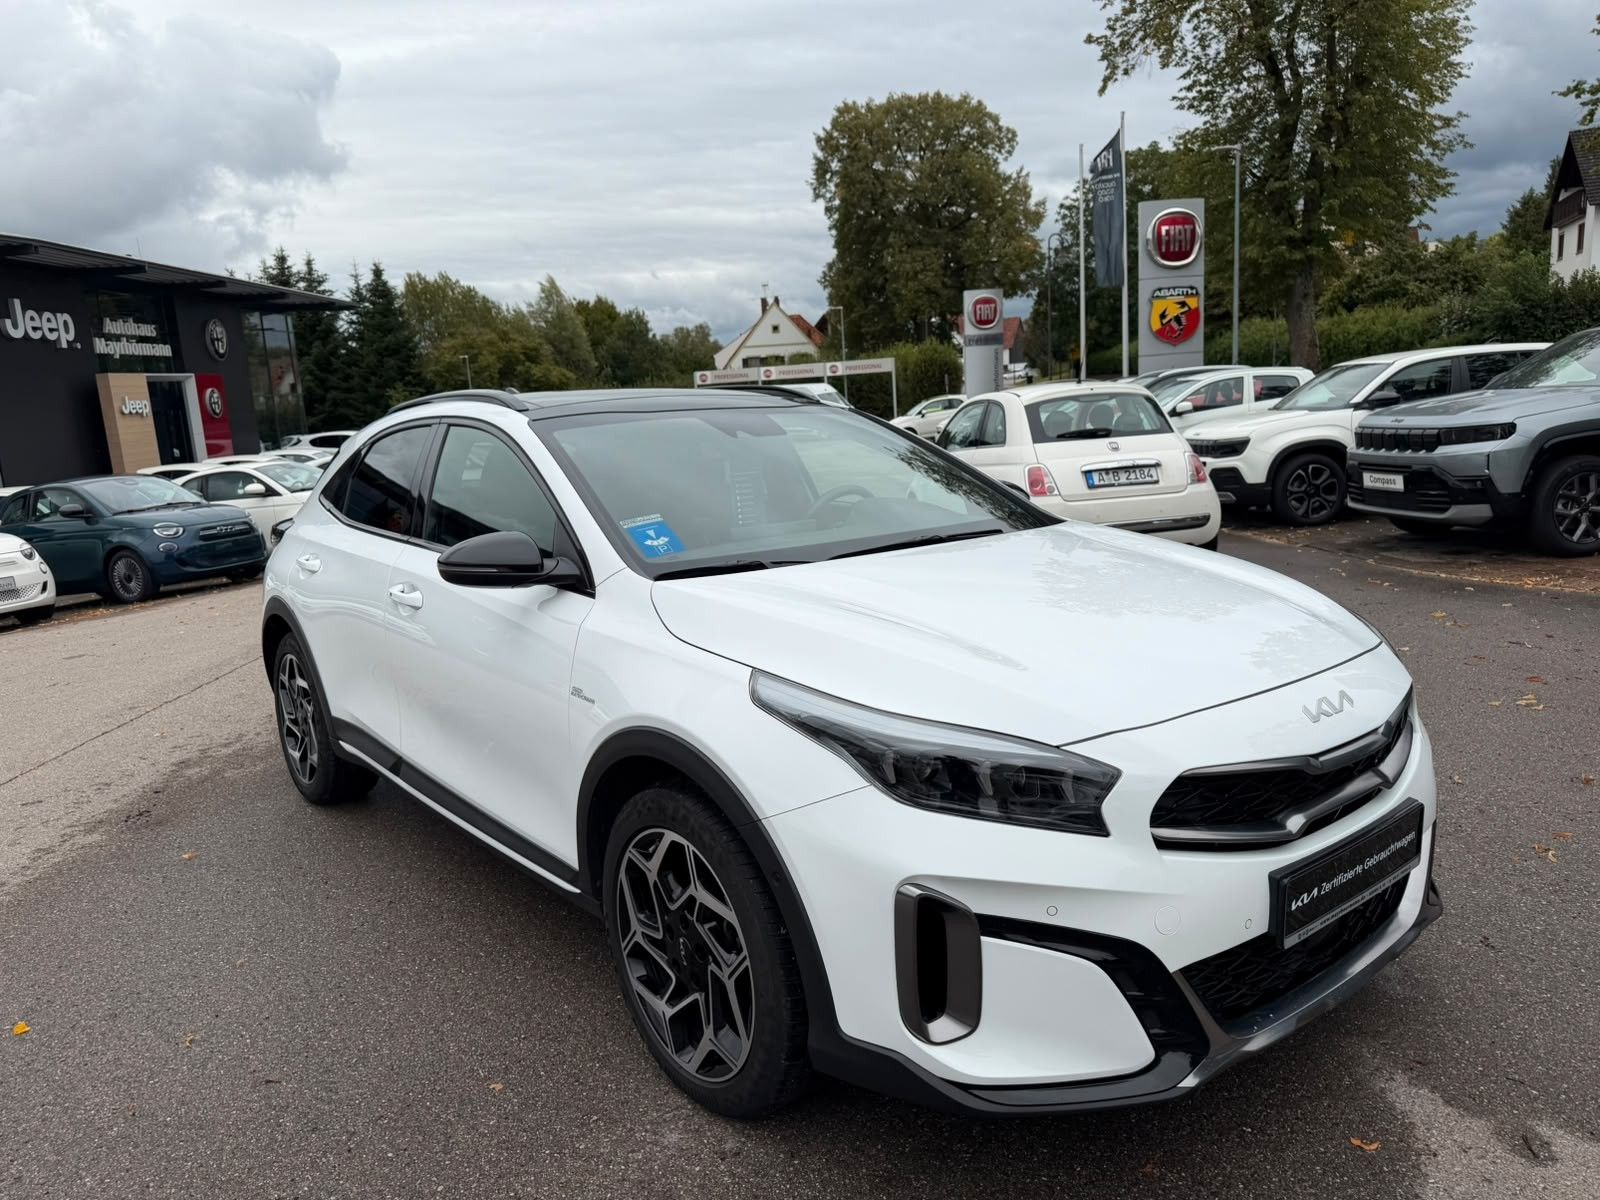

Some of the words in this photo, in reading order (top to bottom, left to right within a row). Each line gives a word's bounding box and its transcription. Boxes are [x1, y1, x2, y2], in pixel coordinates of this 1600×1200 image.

[1160, 224, 1194, 252] FIAT
[1153, 288, 1197, 297] ABARTH
[975, 303, 996, 321] FIAT
[4, 298, 76, 348] Jeep
[103, 317, 157, 336] Autohaus
[122, 395, 149, 416] Jeep
[1097, 472, 1106, 483] A
[1112, 470, 1121, 482] B
[1125, 468, 1154, 481] 2184
[1369, 474, 1397, 486] Compass
[1302, 689, 1354, 723] KIA
[1291, 886, 1319, 911] KIA
[1320, 864, 1364, 895] Zertifizierte
[1364, 831, 1416, 870] Gebrauchtwagen
